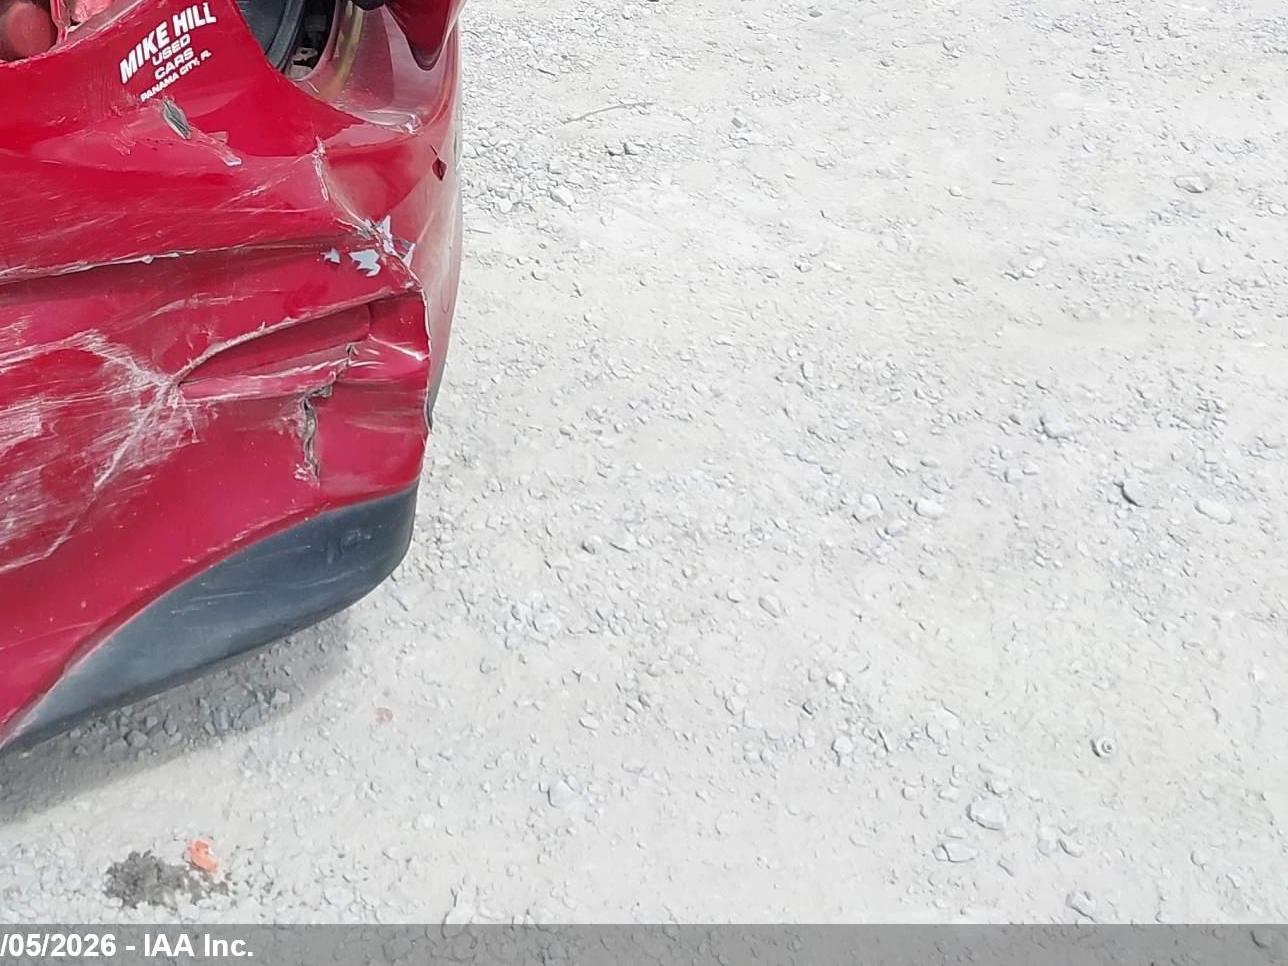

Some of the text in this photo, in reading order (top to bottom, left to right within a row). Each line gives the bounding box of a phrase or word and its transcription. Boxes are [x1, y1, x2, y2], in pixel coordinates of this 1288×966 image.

[120, 1, 217, 84] MIKE HILL
[152, 33, 191, 66] USED
[154, 47, 194, 80] CARS
[140, 72, 179, 102] PANAMA
